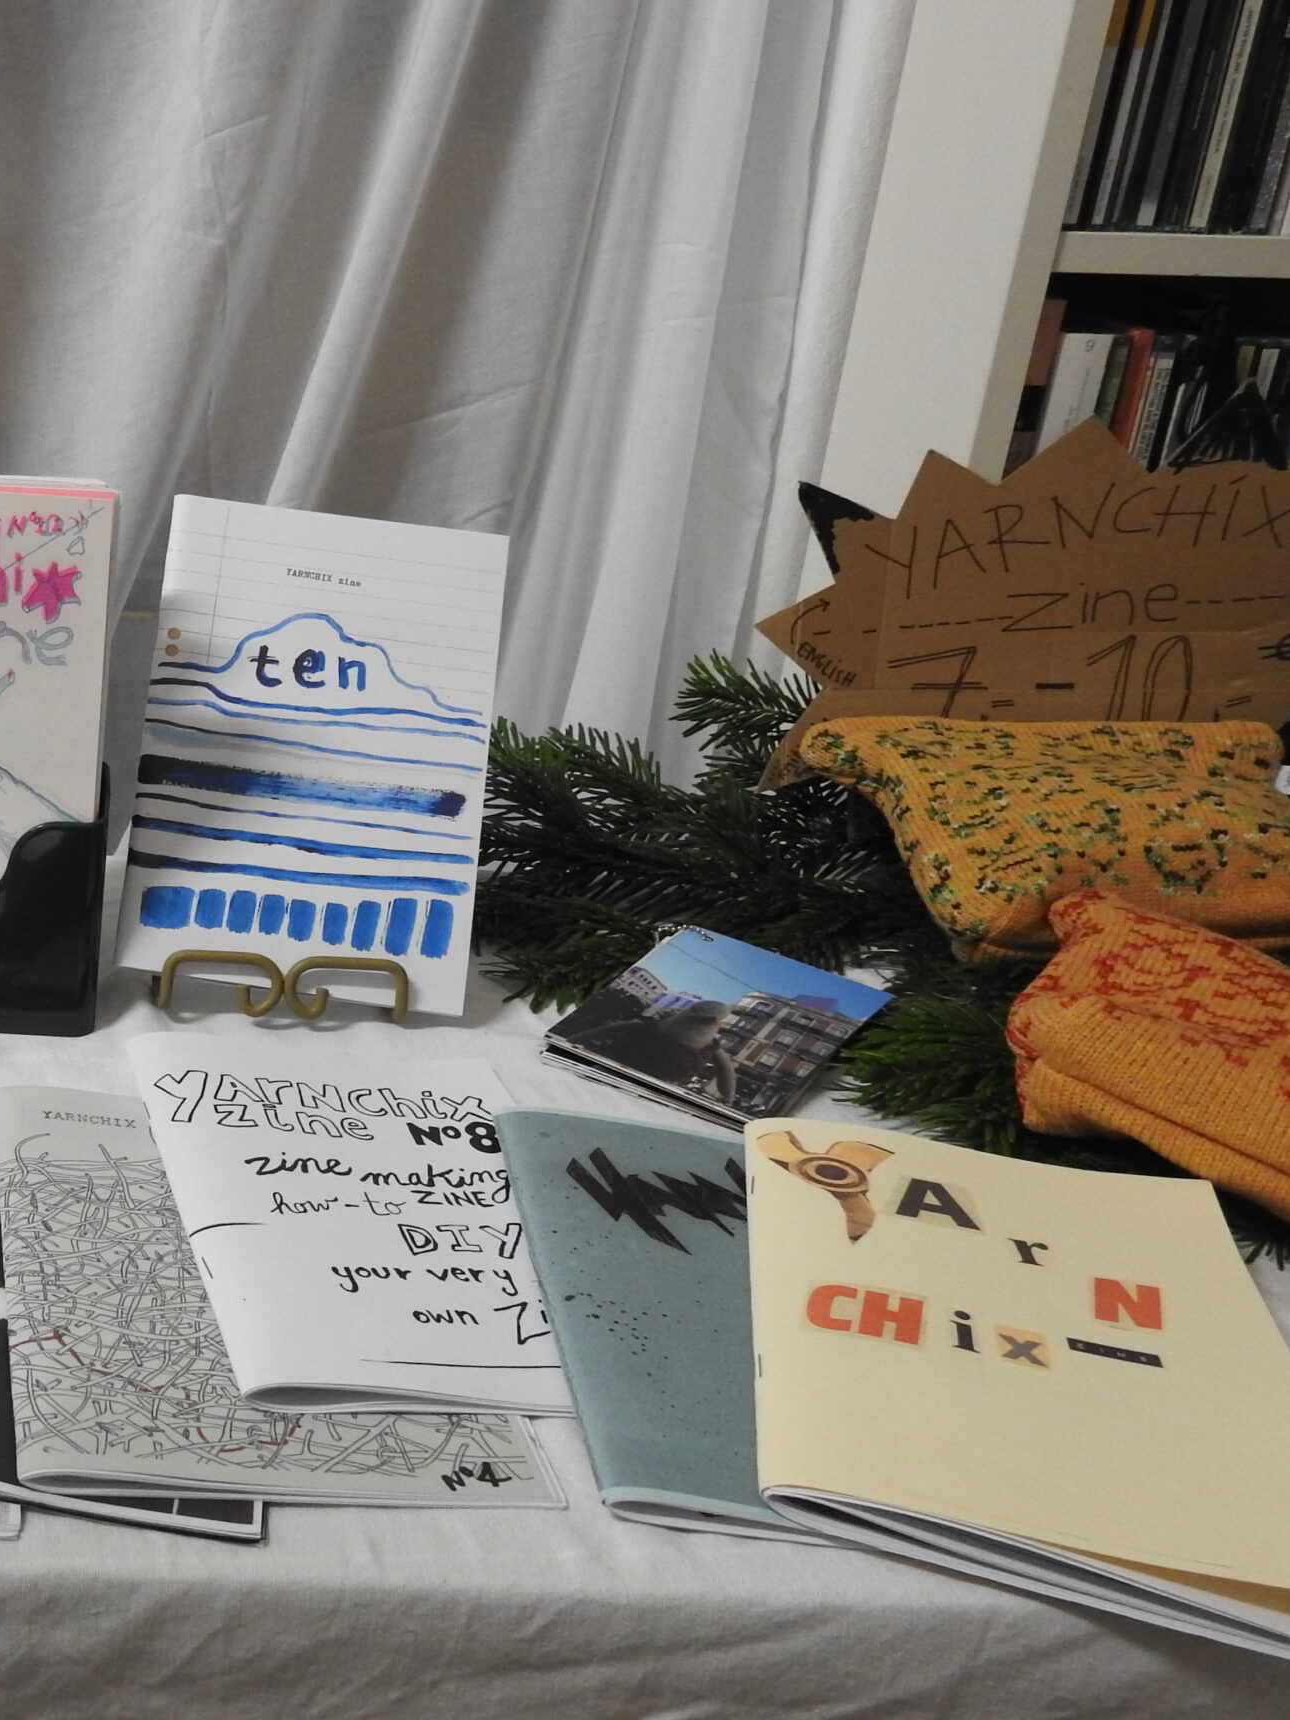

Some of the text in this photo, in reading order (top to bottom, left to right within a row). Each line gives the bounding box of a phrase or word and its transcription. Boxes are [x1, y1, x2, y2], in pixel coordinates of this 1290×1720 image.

[286, 567, 362, 588] YARNCHIX zine
[247, 644, 367, 692] ten
[41, 1108, 138, 1130] YARNCHIX
[359, 1163, 511, 1204] making
[410, 1189, 495, 1208] ZINE
[397, 1222, 523, 1260] DIY
[331, 1264, 519, 1297] your very
[412, 1299, 552, 1346] own Zi
